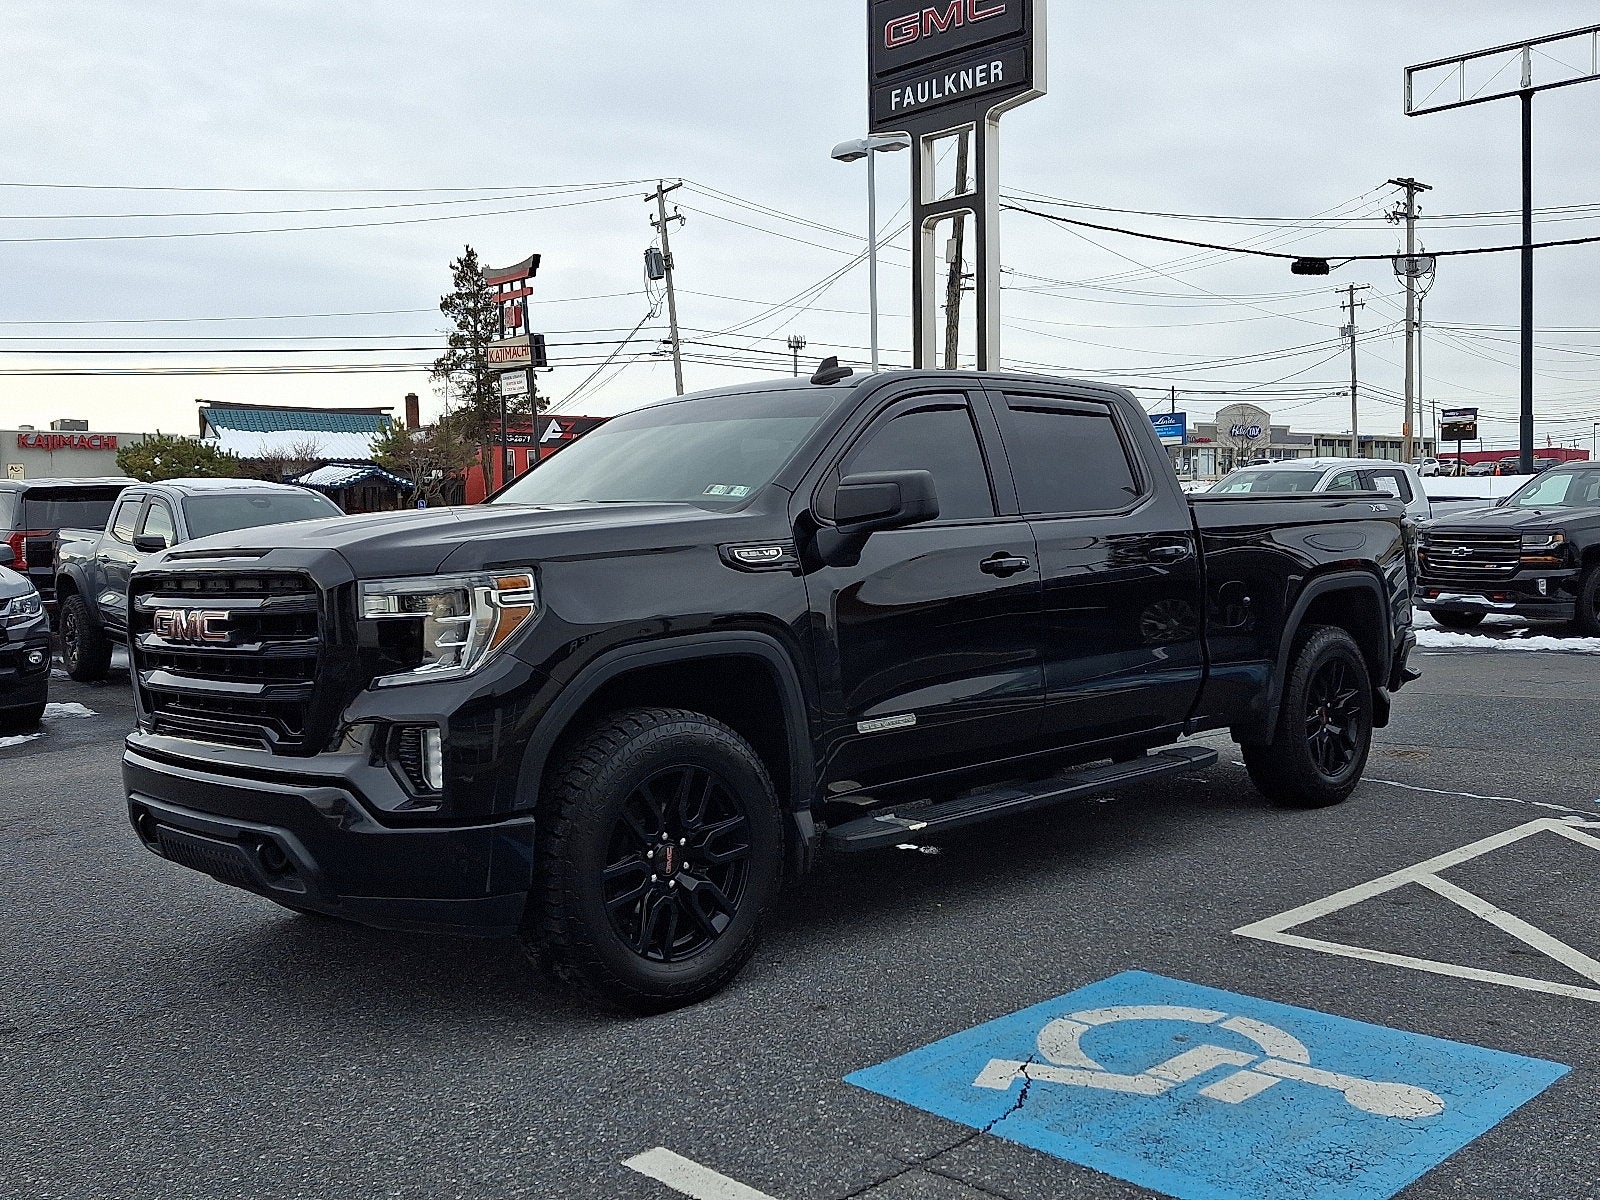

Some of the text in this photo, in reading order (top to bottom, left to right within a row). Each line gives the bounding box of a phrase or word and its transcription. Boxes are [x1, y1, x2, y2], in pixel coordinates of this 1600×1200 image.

[885, 0, 1006, 48] GMC
[891, 60, 1003, 111] FAULKNER
[489, 344, 529, 363] KAJIMACHI
[17, 434, 117, 452] KAJIMACHI
[154, 609, 231, 642] GMC
